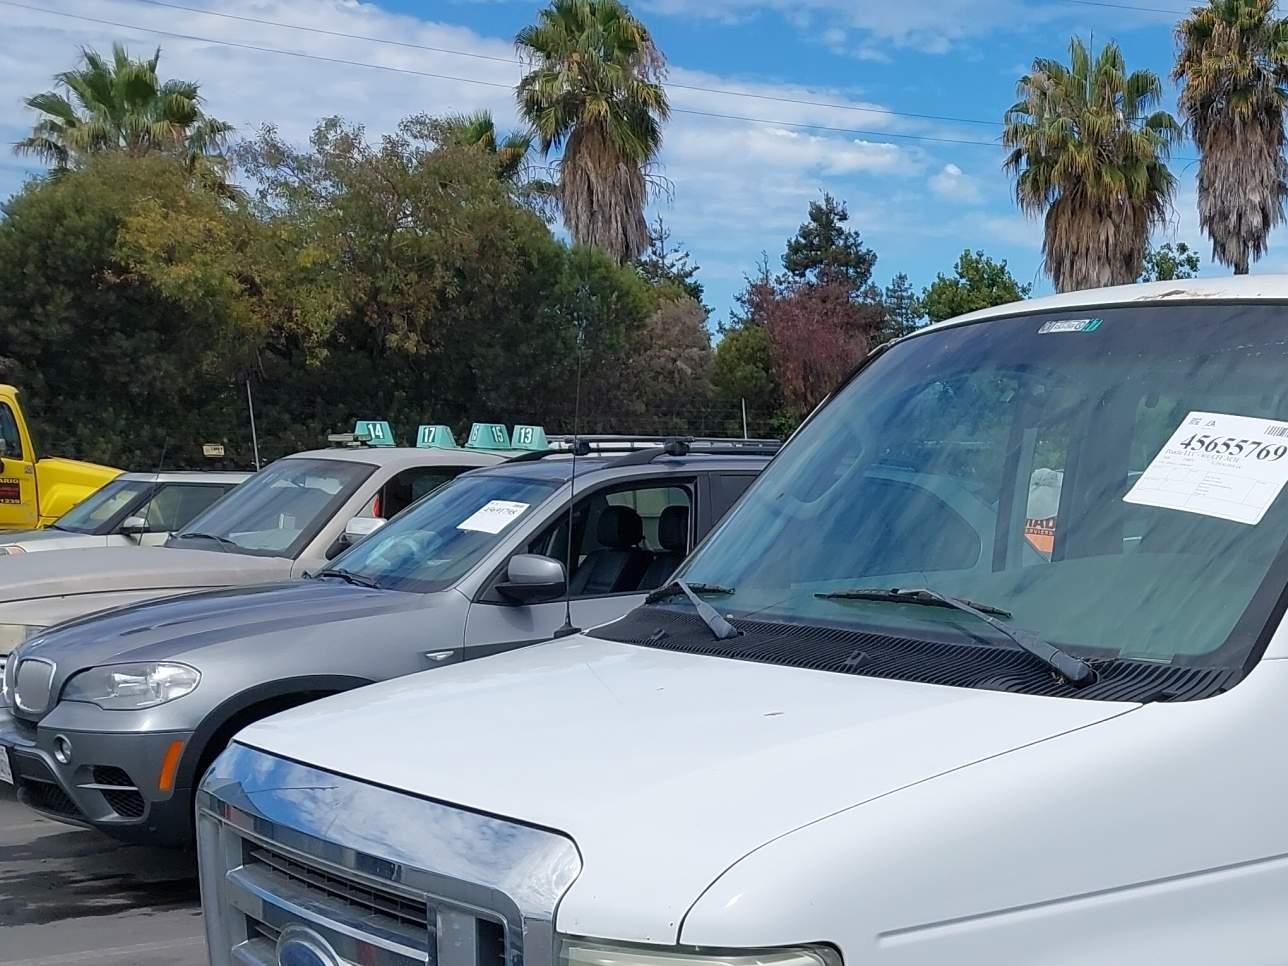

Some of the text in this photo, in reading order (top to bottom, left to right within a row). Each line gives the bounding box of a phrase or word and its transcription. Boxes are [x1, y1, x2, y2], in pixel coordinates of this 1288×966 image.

[368, 423, 384, 439] 14
[424, 427, 435, 443] 17
[491, 426, 504, 442] 15
[520, 427, 532, 443] 13
[1180, 433, 1288, 462] 45655769
